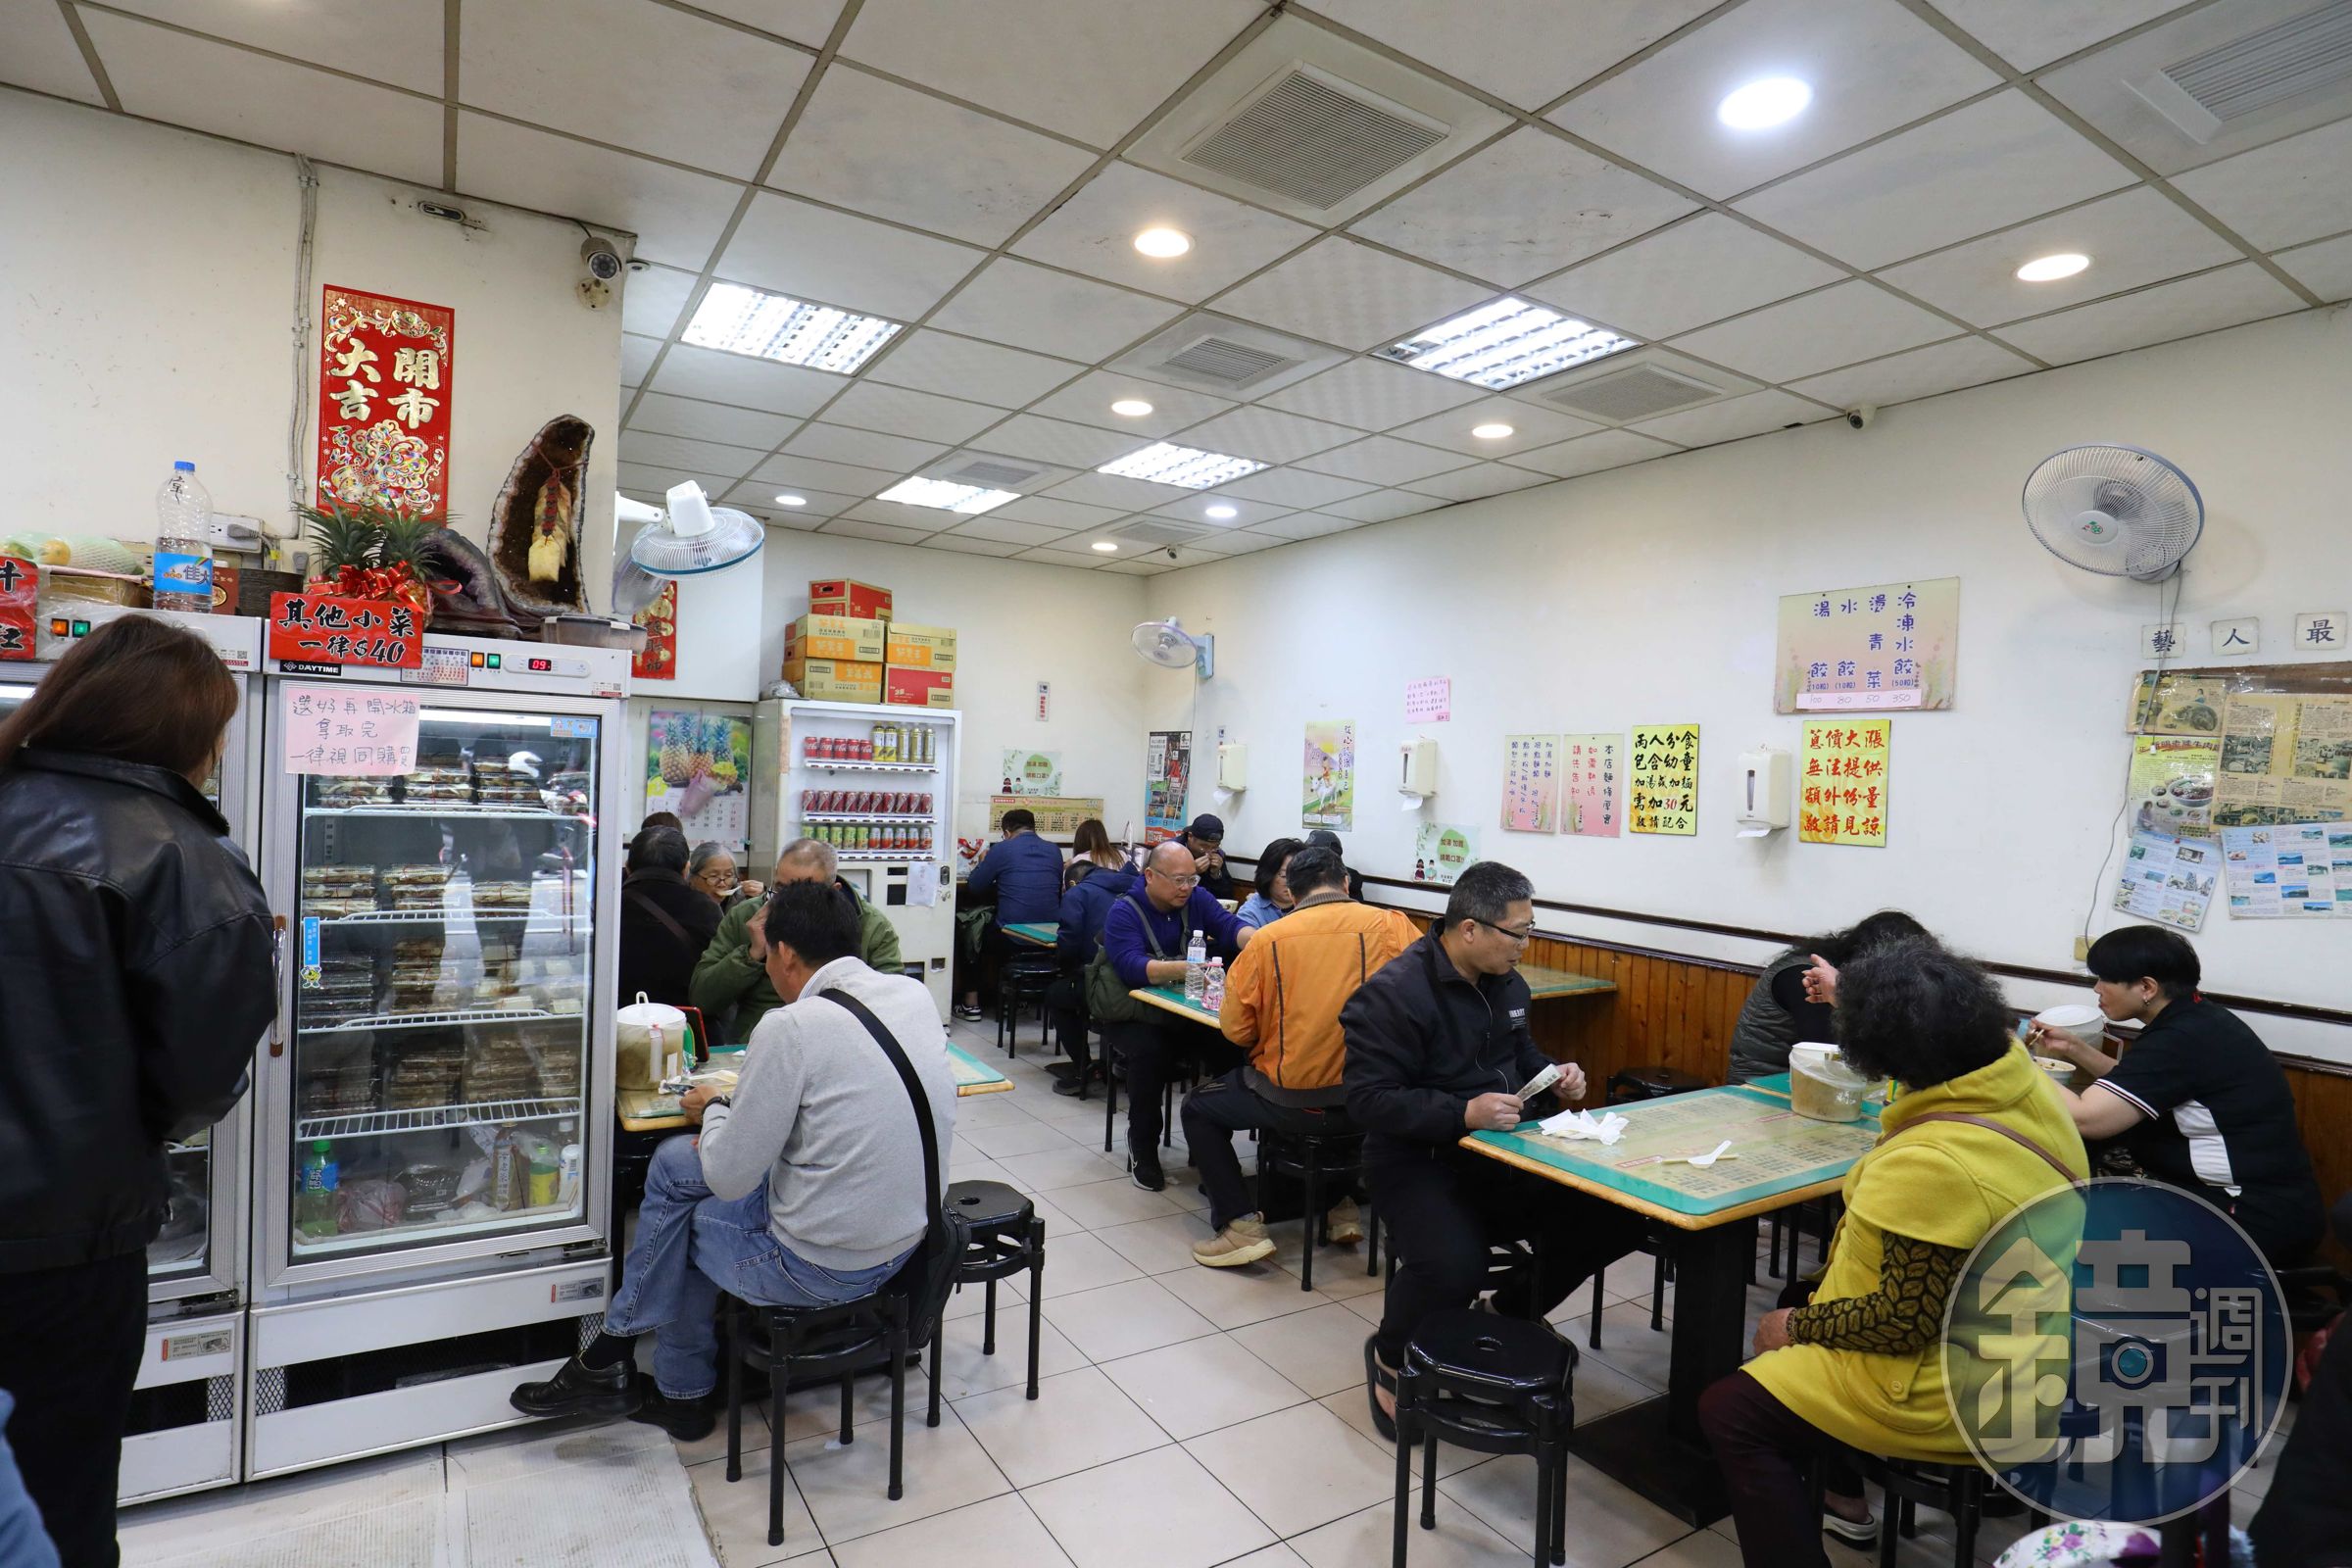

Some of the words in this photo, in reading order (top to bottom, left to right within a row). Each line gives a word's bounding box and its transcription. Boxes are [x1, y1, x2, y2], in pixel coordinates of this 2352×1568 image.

[328, 338, 381, 421] 大吉
[387, 347, 440, 429] 開市
[278, 598, 415, 637] 其他小菜
[1866, 594, 1886, 689] 燙青菜
[1893, 592, 1917, 675] 冷凍水餃
[298, 635, 406, 663] 一律$40
[298, 664, 339, 674] DAYTIME
[292, 695, 416, 715] 選好再開冰箱
[1891, 694, 1911, 703] 350
[316, 717, 378, 740] 拿取完
[1809, 728, 1885, 750] 蔥價大漲
[289, 746, 411, 767] 一律視同購買
[1634, 751, 1695, 771] 包含幼童
[1805, 757, 1883, 779] 無法提供
[1635, 774, 1692, 790] 加湯或加麵
[1633, 792, 1693, 812] 需加30元
[1804, 786, 1881, 808] 額外份量
[1636, 815, 1688, 829] 敬請配合
[1804, 813, 1881, 837] 敬請見諒
